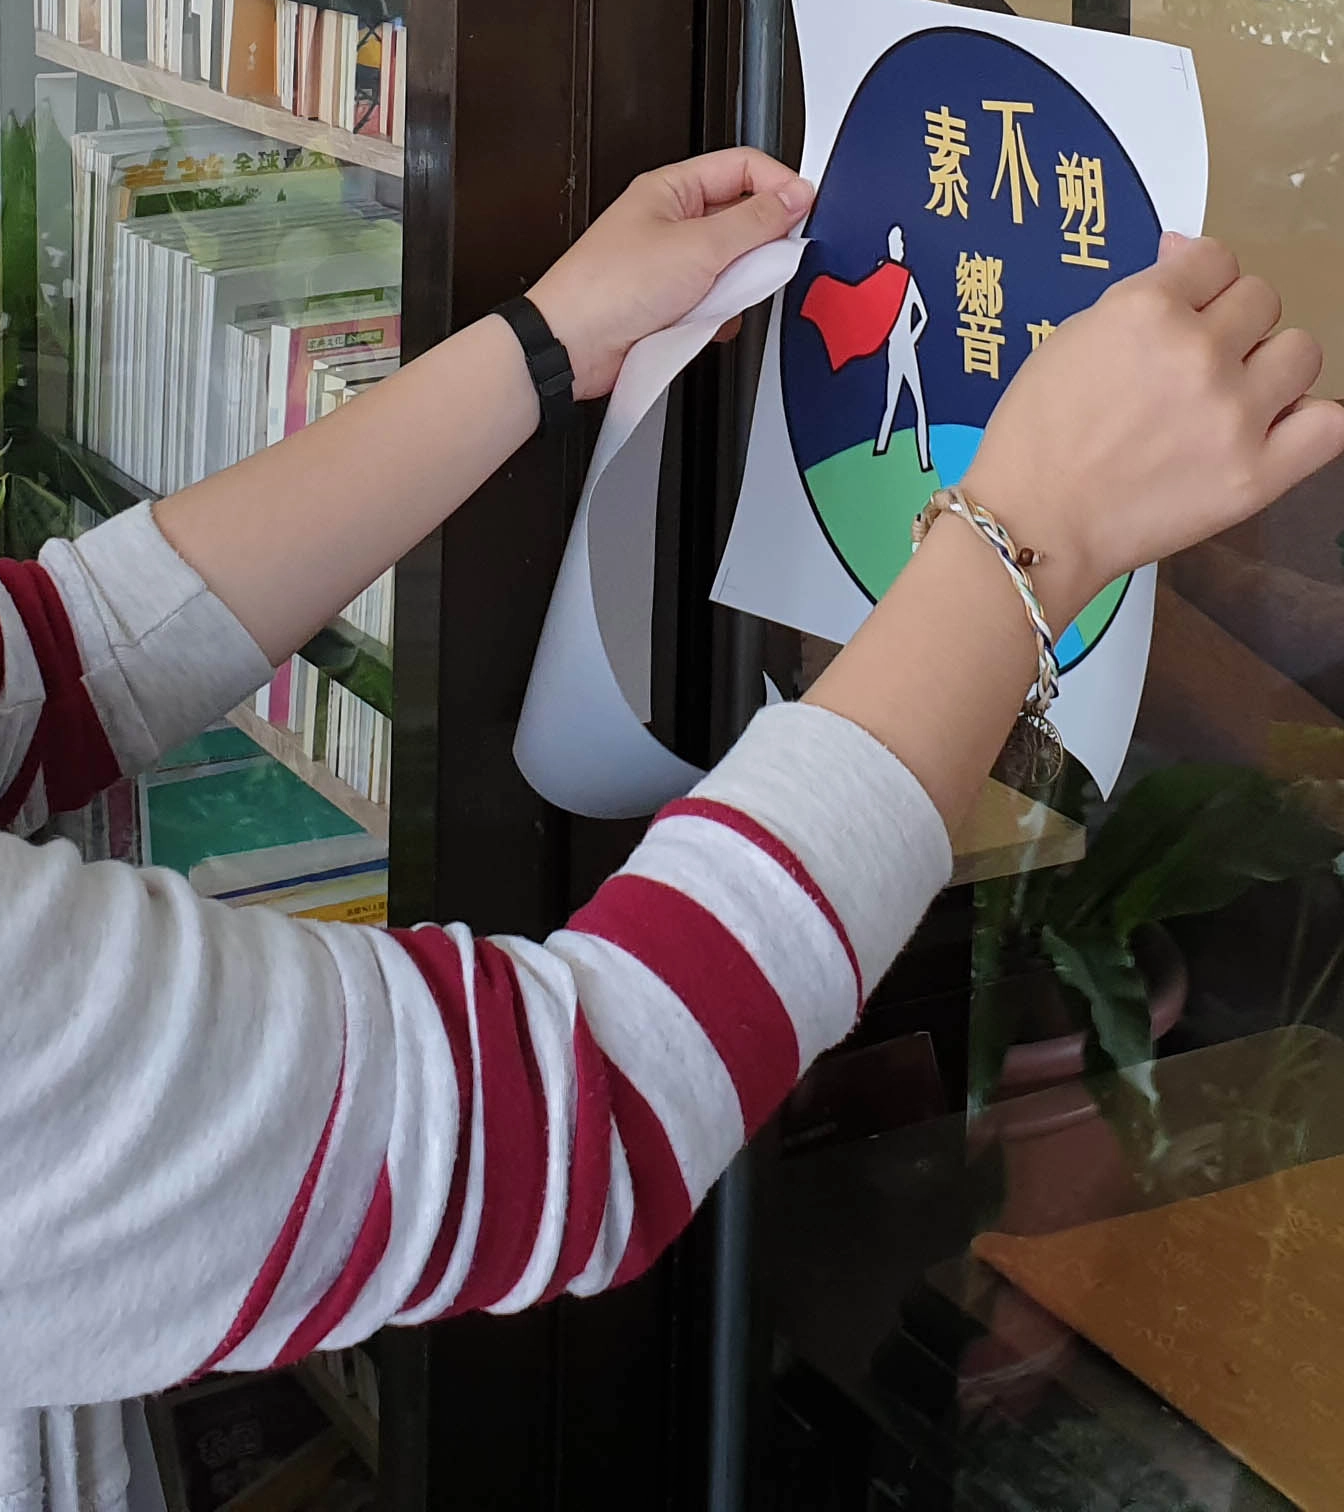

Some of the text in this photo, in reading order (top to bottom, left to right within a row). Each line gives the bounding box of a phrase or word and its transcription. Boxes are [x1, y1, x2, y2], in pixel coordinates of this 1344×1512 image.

[924, 99, 1110, 270] 素不塑
[955, 250, 1057, 379] 響
